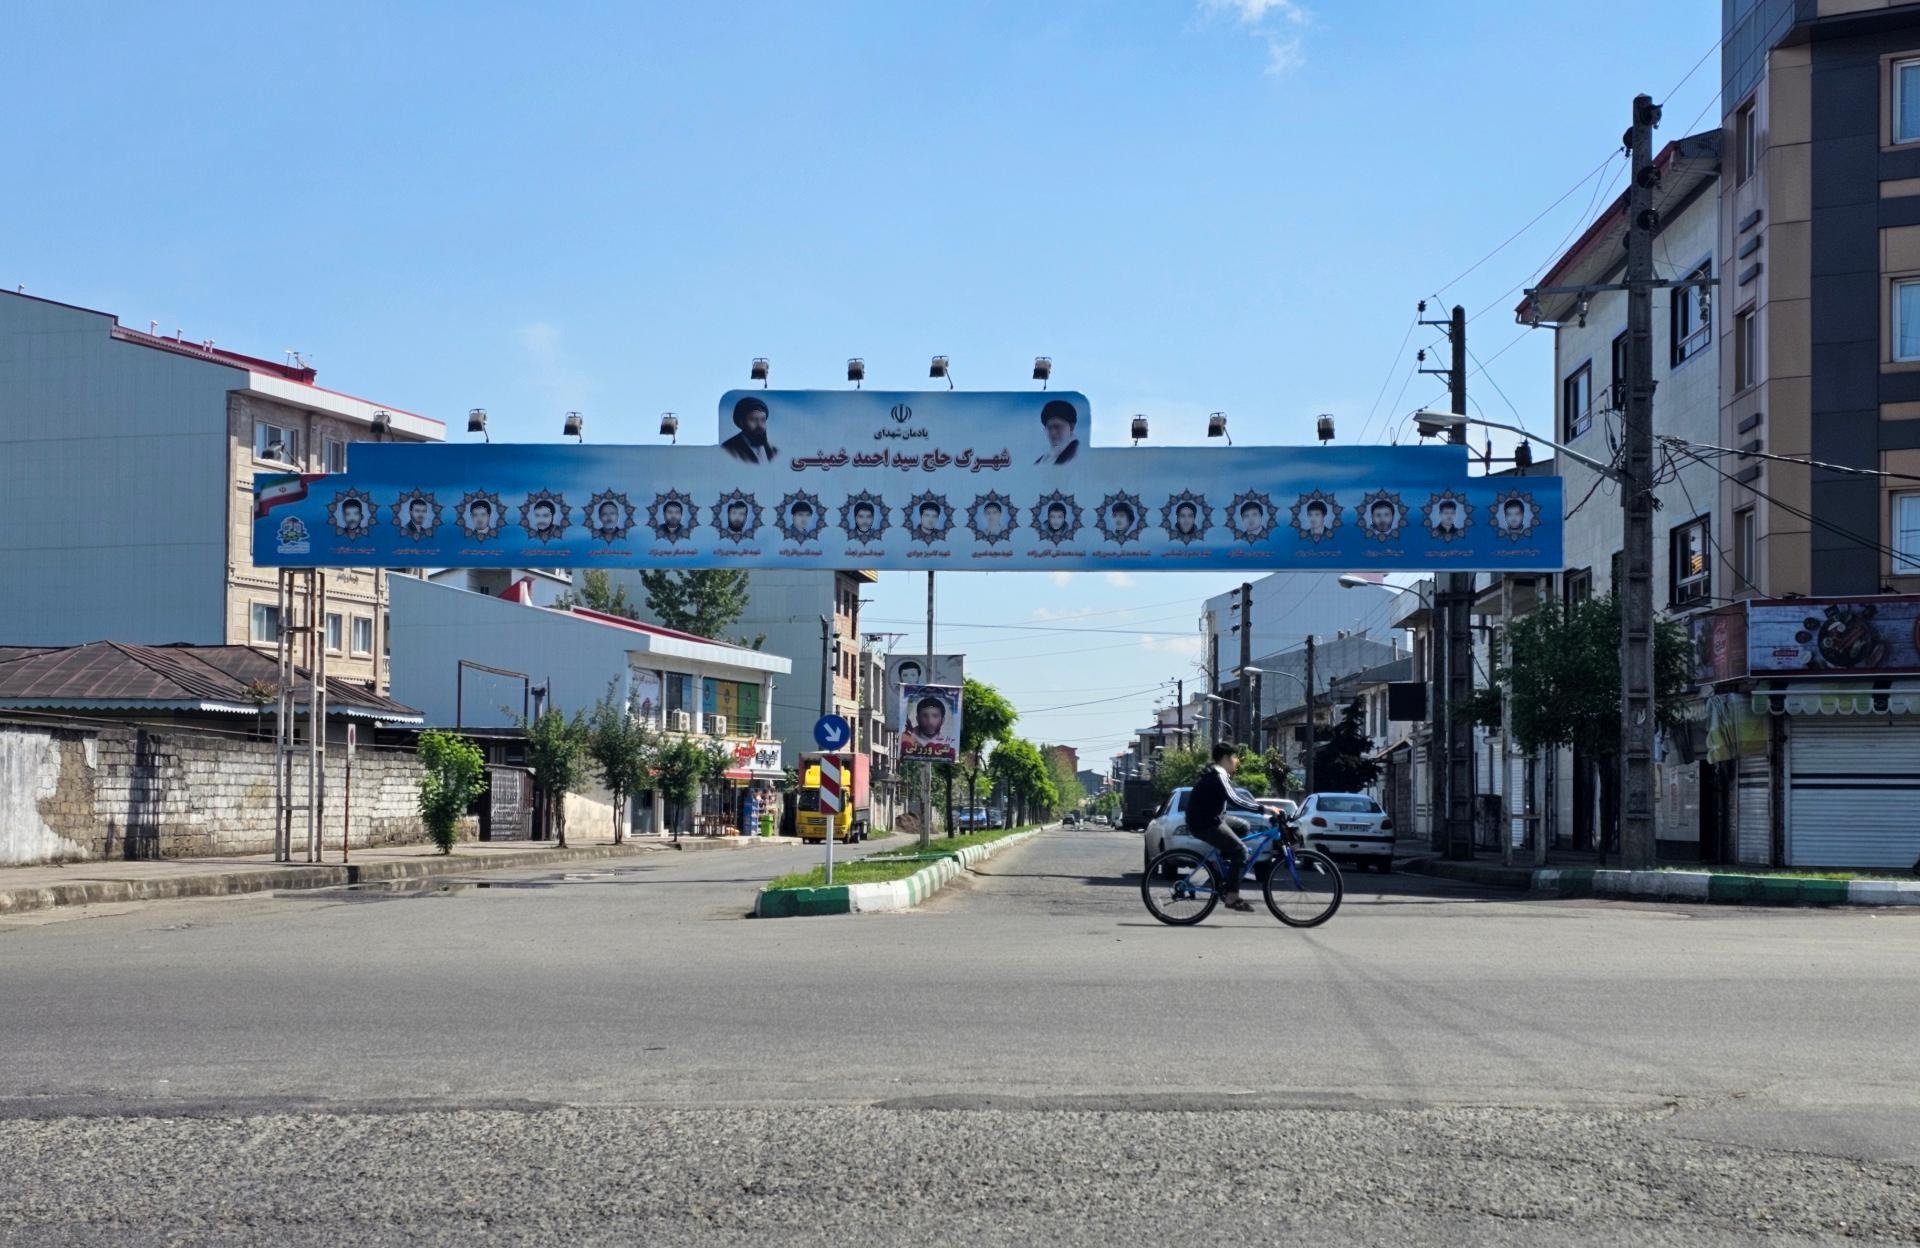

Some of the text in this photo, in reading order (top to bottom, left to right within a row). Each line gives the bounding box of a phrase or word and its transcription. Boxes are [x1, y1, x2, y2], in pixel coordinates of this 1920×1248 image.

[874, 428, 929, 441] یادمان شهدای
[790, 447, 1010, 473] شهرک حاج سید احمد خمینی
